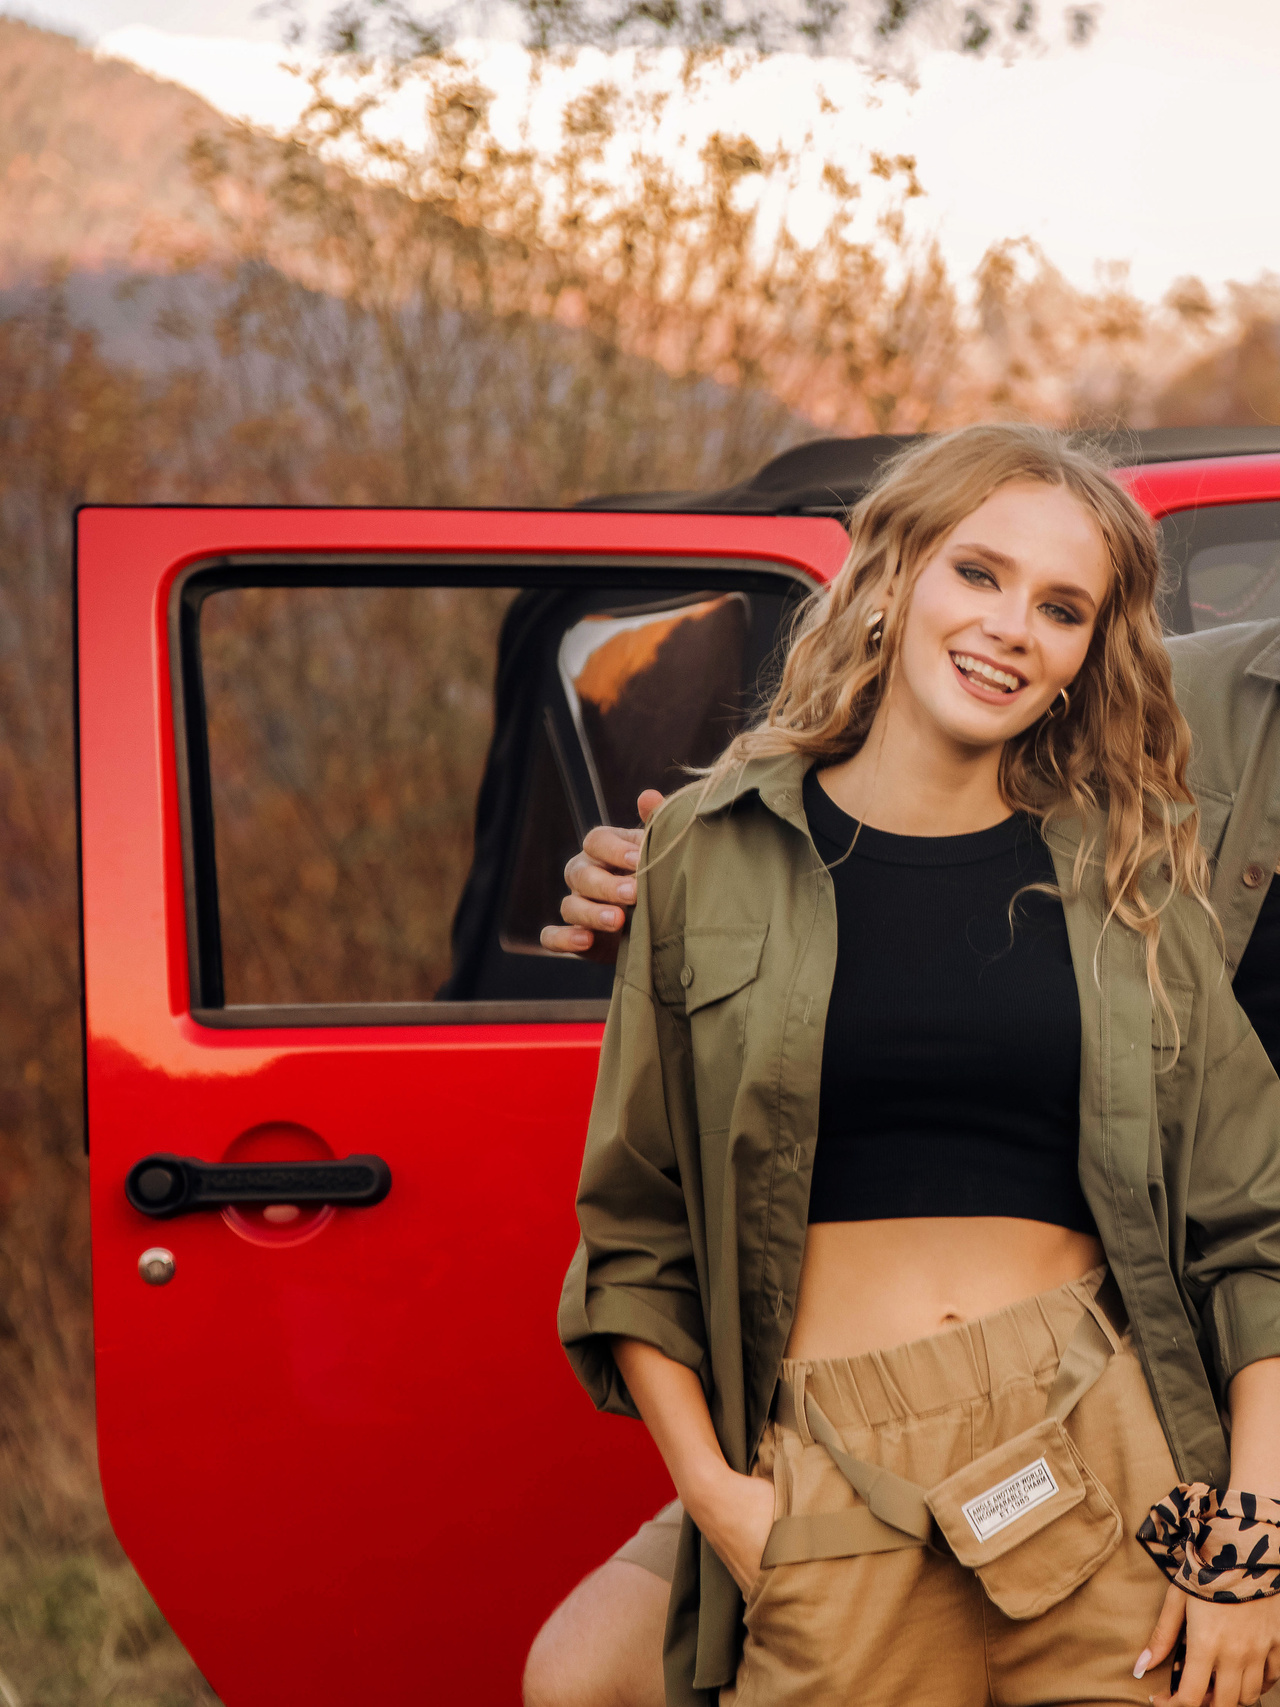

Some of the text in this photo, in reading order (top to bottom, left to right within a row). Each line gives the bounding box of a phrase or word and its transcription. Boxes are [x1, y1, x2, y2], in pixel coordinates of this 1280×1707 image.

[976, 1475, 1047, 1524] INCOMPARABLE CHARM
[992, 1481, 1020, 1503] ANOTHER
[1021, 1468, 1043, 1484] WORLD
